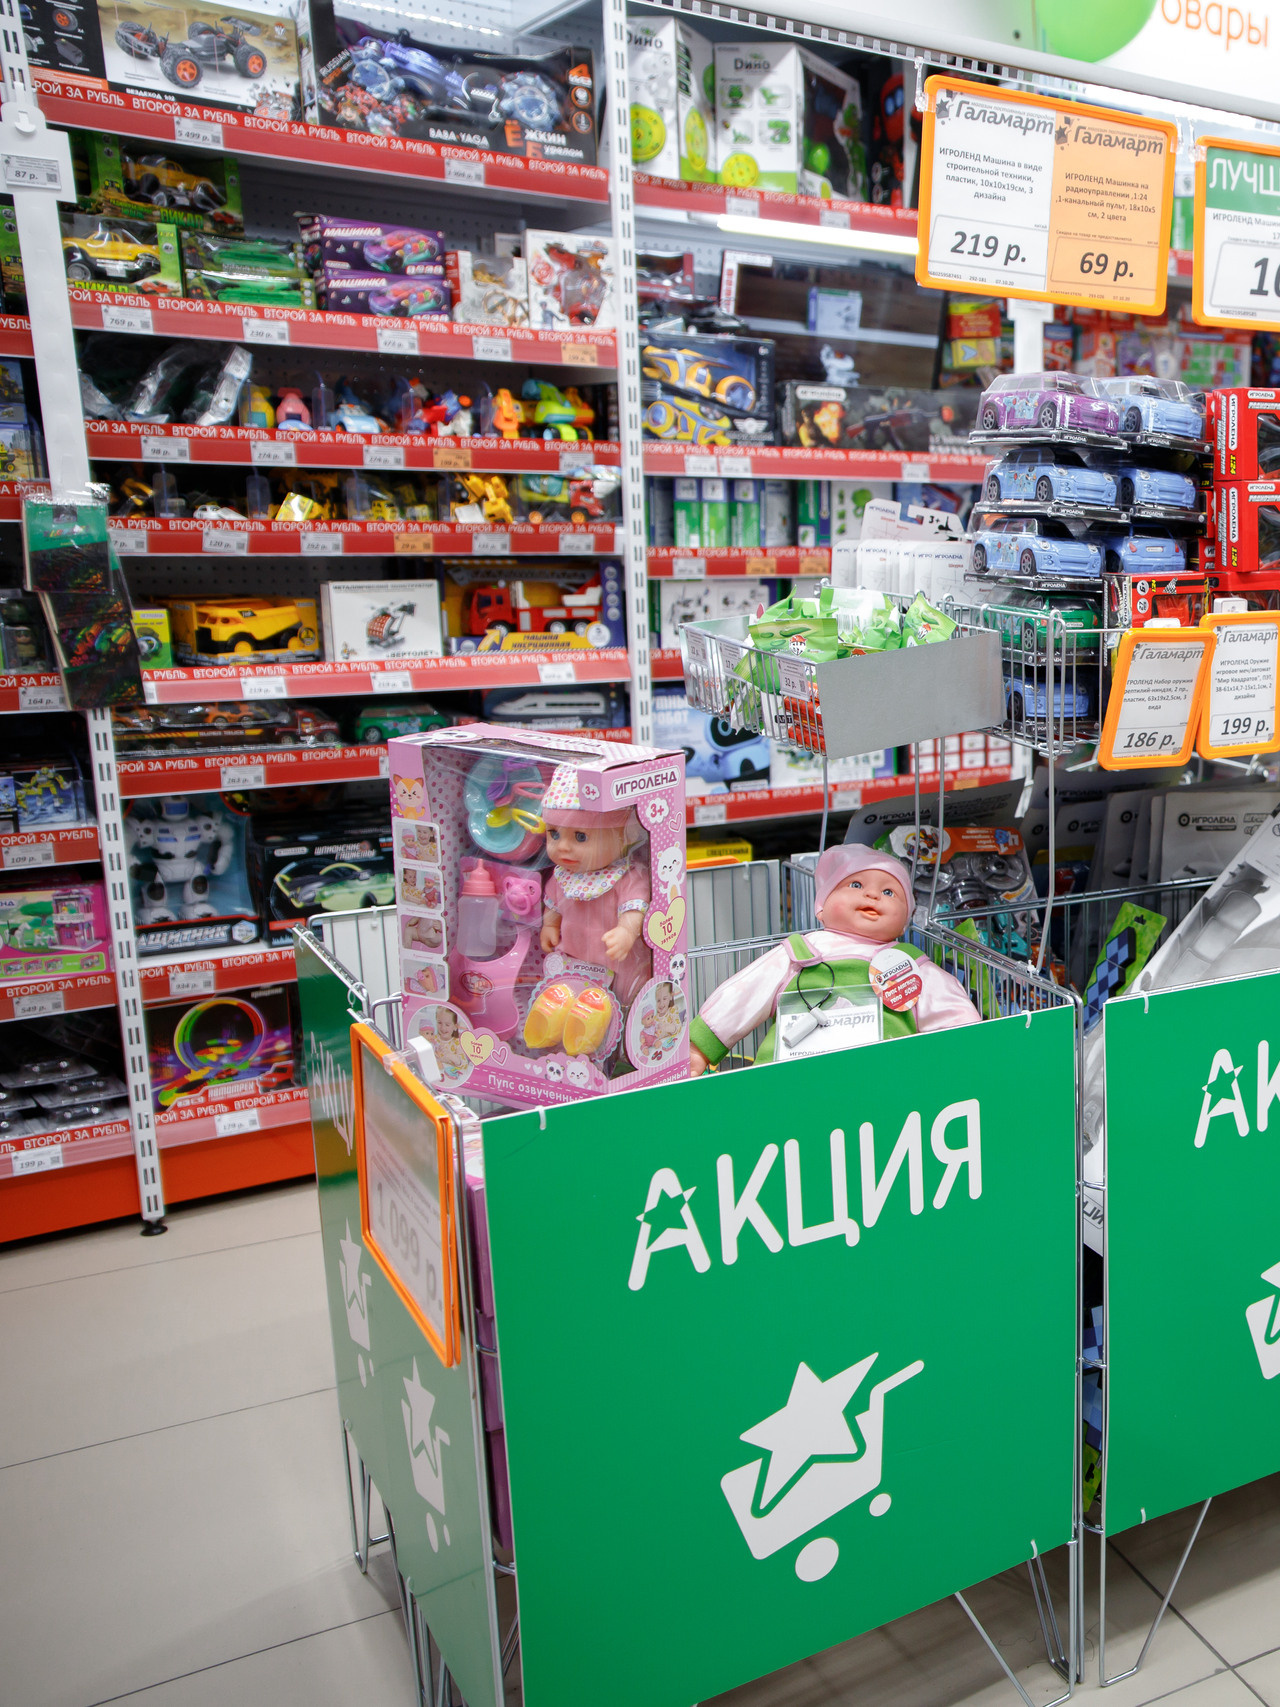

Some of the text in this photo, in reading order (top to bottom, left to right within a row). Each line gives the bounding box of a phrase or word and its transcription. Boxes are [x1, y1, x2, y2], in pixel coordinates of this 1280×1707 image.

[1161, 0, 1268, 51] овары
[132, 98, 238, 126] ВТОРОЙ ЗА РУБЛЬ
[955, 101, 1054, 135] Галамарт
[243, 115, 340, 141] ВТОРОЙ ЗА РУБЛЬ
[1073, 125, 1164, 156] Галамарт
[939, 147, 981, 162] ИГРОЛЕНД
[982, 154, 1016, 168] Машина
[1023, 162, 1043, 172] виде
[14, 169, 39, 181] 87 р.
[945, 175, 979, 186] пластик,
[946, 163, 1034, 183] строительной техники,
[1064, 172, 1104, 185] ИГРОЛЕНД
[1105, 180, 1140, 190] Машинка
[973, 191, 1006, 203] дизайна
[1065, 185, 1130, 201] радиоуправлении
[1106, 202, 1128, 213] пульт,
[1087, 212, 1100, 220] см,
[1107, 214, 1127, 224] цвета
[1212, 212, 1254, 226] ИГРОЛЕНД
[323, 226, 382, 238] МАШИНКА
[950, 230, 1027, 266] 219 р.
[1079, 251, 1134, 281] 69 р.
[328, 277, 388, 289] МАШИНКА
[157, 297, 258, 318] ВТОРОЙ ЗА РУБЛЬ
[361, 315, 450, 335] ВТОРОЙ ЗА РУБЛЬ
[172, 425, 270, 441] ВТОРОЙ ЗА РУБЛЬ
[168, 518, 267, 532] ВТОРОЙ ЗА РУБЛЬ
[928, 515, 940, 524] 3+
[1139, 648, 1205, 663] Галамарт
[1219, 658, 1249, 666] ИГРОЛЕНД
[193, 666, 288, 679] ВТОРОЙ ЗА РУБЛЬ
[784, 677, 792, 687] 32
[1220, 717, 1270, 737] 199 р.
[1123, 731, 1176, 750] 186 р.
[204, 752, 297, 768] ВТОРОЙ ЗА РУБЛЬ
[584, 785, 597, 797] 3+
[615, 773, 678, 796] ИГРОЛЕНД
[649, 803, 665, 817] 3+
[1191, 816, 1236, 824] ИГРОЛЕНД
[662, 922, 673, 936] 10
[573, 963, 606, 974] ИГРОЛЕНД
[882, 961, 910, 979] ИГРОЛЕНД
[6, 974, 111, 997] ВТОРОЙ ЗА РУБЛЬ
[884, 987, 899, 999] Пупс
[472, 1045, 481, 1055] 10
[487, 1073, 515, 1090] Пупс
[23, 1124, 127, 1150] ВТОРОЙ ЗА РУБЛЬ
[627, 1097, 983, 1292] АКЦИЯ
